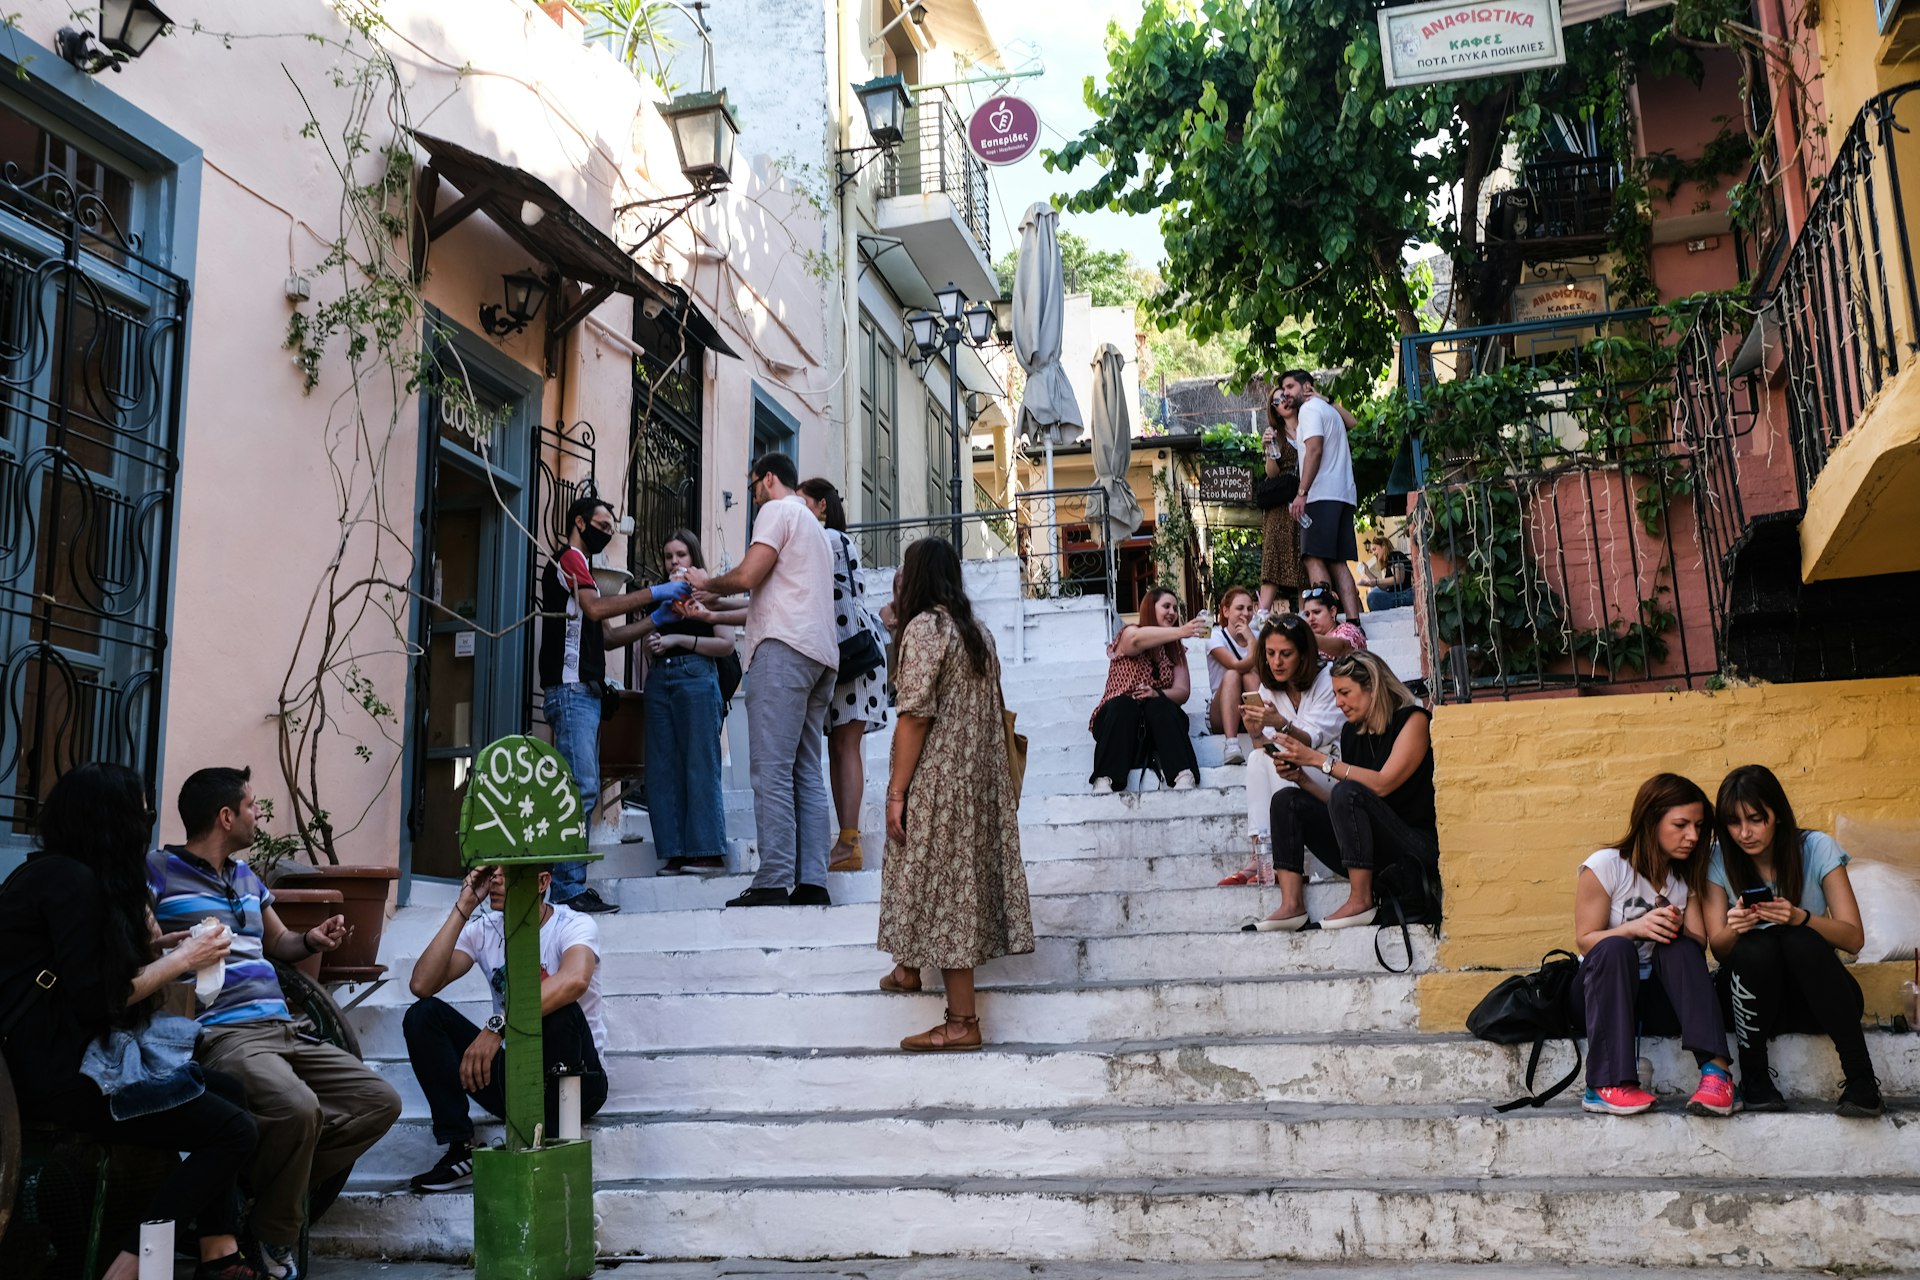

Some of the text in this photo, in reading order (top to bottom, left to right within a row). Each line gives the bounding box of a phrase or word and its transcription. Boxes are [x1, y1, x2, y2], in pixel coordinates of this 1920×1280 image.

[1421, 8, 1535, 40] ΑΝΑΦΙΩΤΙΚΑ
[1449, 33, 1503, 51] ΚΑΦΕΣ
[1417, 41, 1545, 69] ΠΟΤΑ ΓΛΥΚΑ ΠΟΙΚΙΛΙΕΣ
[1533, 290, 1597, 308] ΑΝΑΦΙΩΤΙΚΑ
[1547, 302, 1583, 313] ΚΑΦΕΣ
[1205, 466, 1250, 478] ΤΑΒΕΡΝΑ
[1206, 490, 1220, 499] του
[1730, 969, 1761, 1049] Adidas
